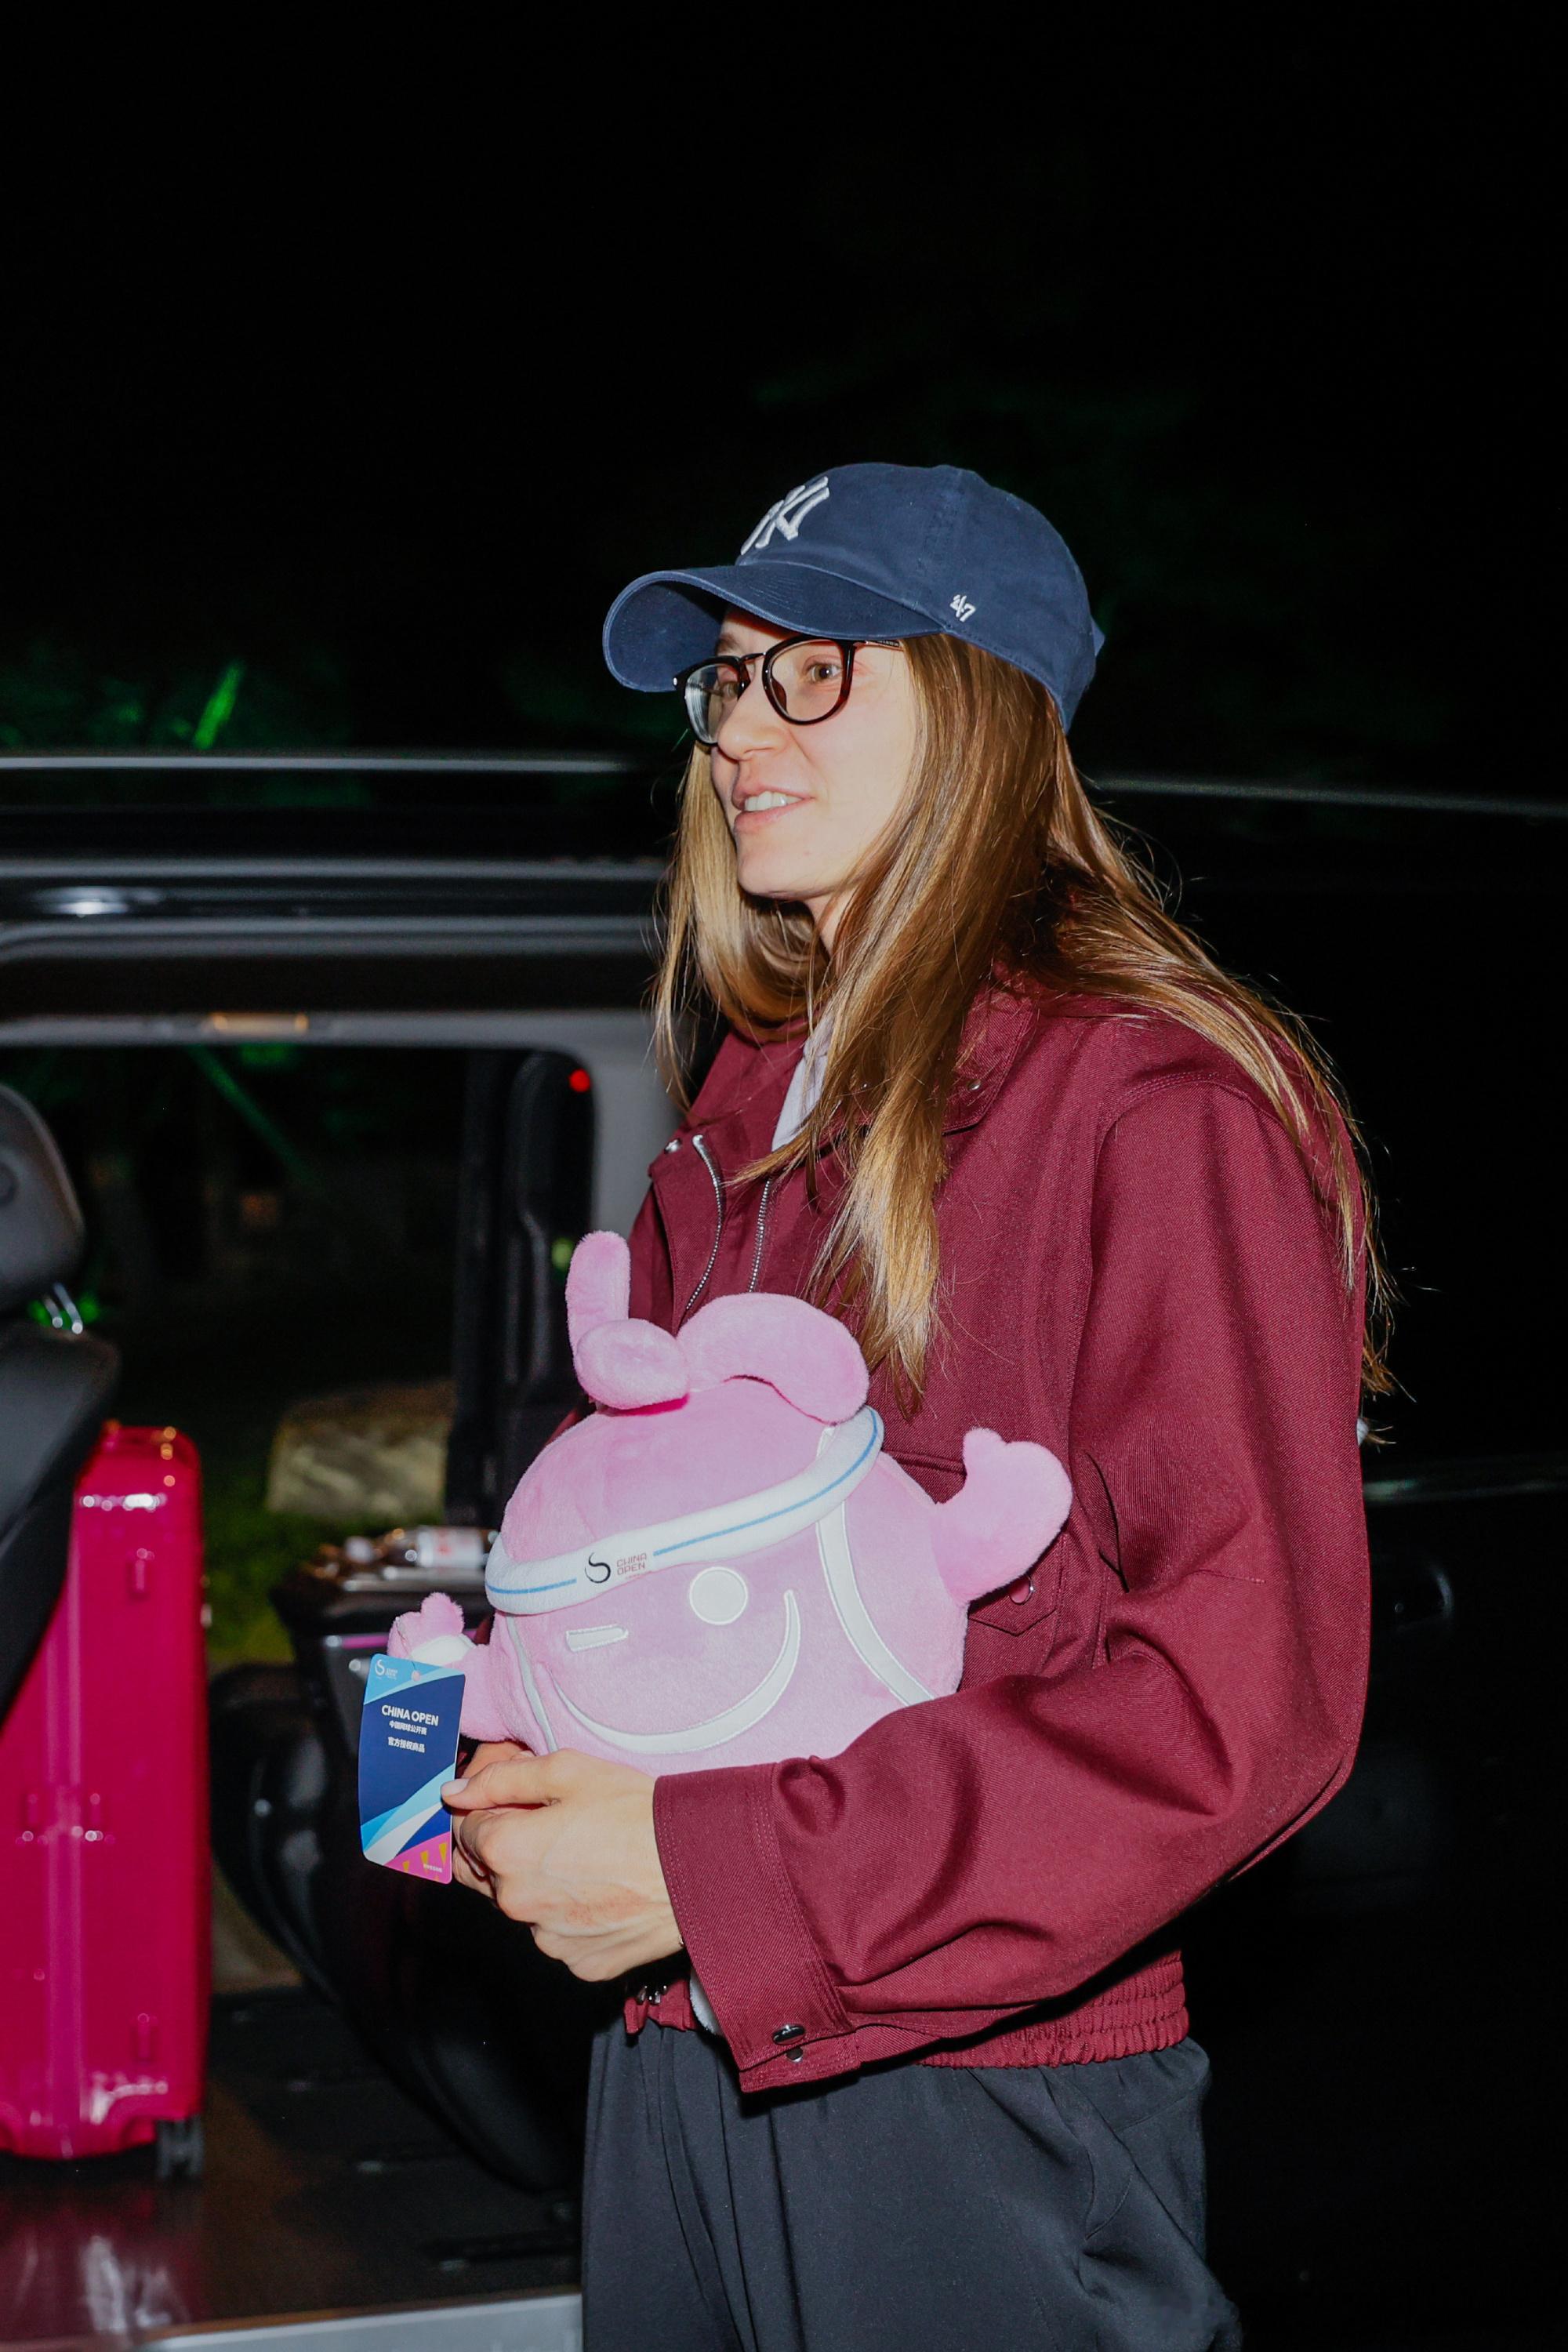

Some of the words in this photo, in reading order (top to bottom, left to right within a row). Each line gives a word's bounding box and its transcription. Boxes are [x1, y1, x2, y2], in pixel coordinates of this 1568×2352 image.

[616, 1552, 648, 1568] CHINA
[616, 1562, 646, 1576] OPEN
[381, 1704, 410, 1720] CHINA
[411, 1711, 439, 1726] OPEN
